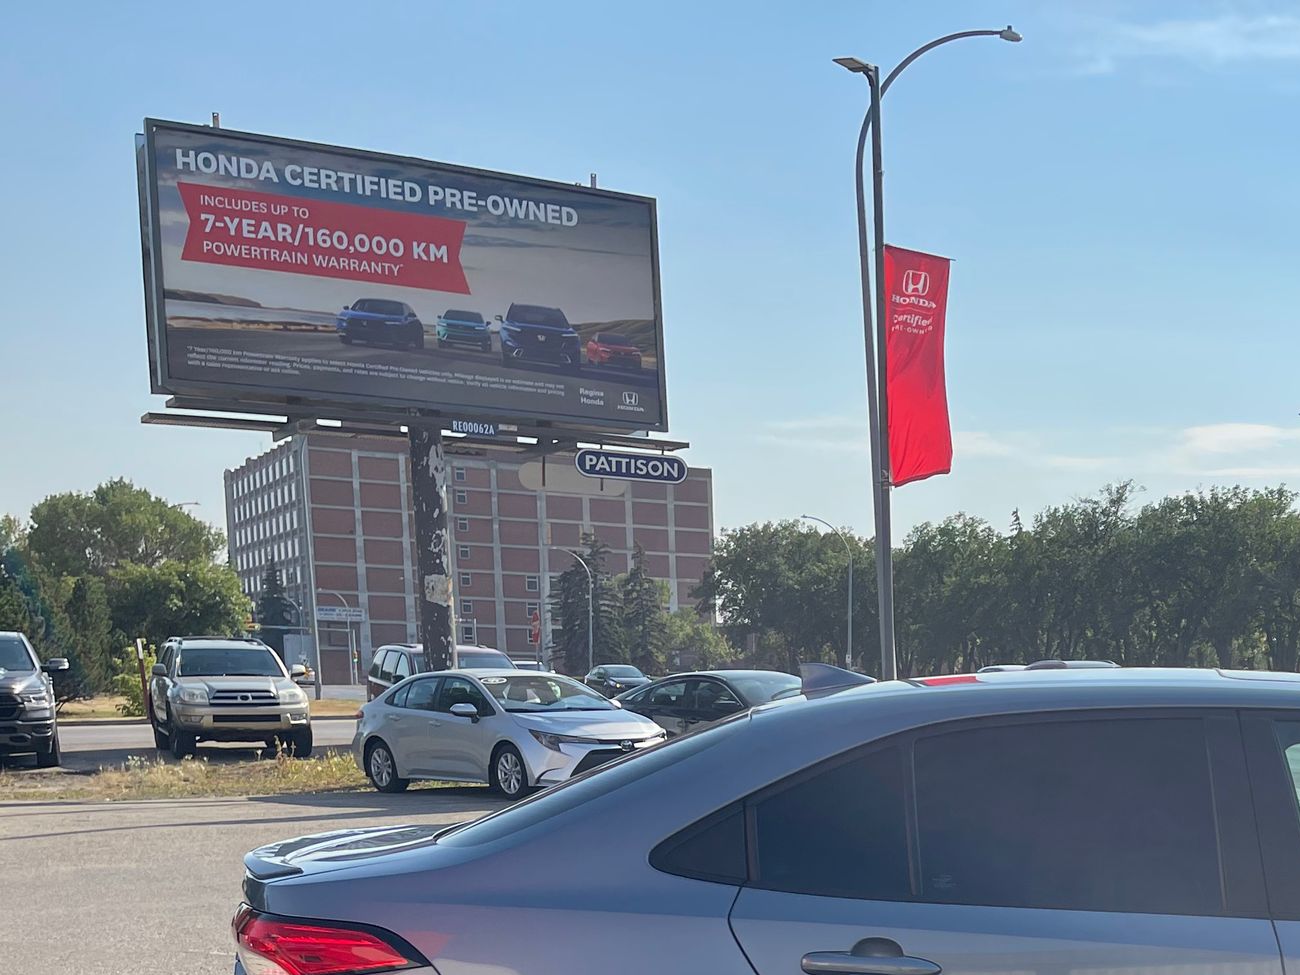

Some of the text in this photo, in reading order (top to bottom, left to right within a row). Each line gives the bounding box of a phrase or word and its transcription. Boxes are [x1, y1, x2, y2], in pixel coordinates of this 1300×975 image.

[175, 148, 578, 227] HONDA CERTIFIED PRE-OWNED
[200, 194, 309, 219] INCLUDES UP TO
[200, 213, 448, 263] 7-YEAR/160,000 KM
[202, 240, 308, 265] POWERTRAIN
[891, 294, 937, 309] HONDA
[579, 387, 604, 397] Regina
[580, 396, 604, 406] Honda
[452, 420, 495, 436] RE00062A
[585, 454, 679, 479] PATTISON
